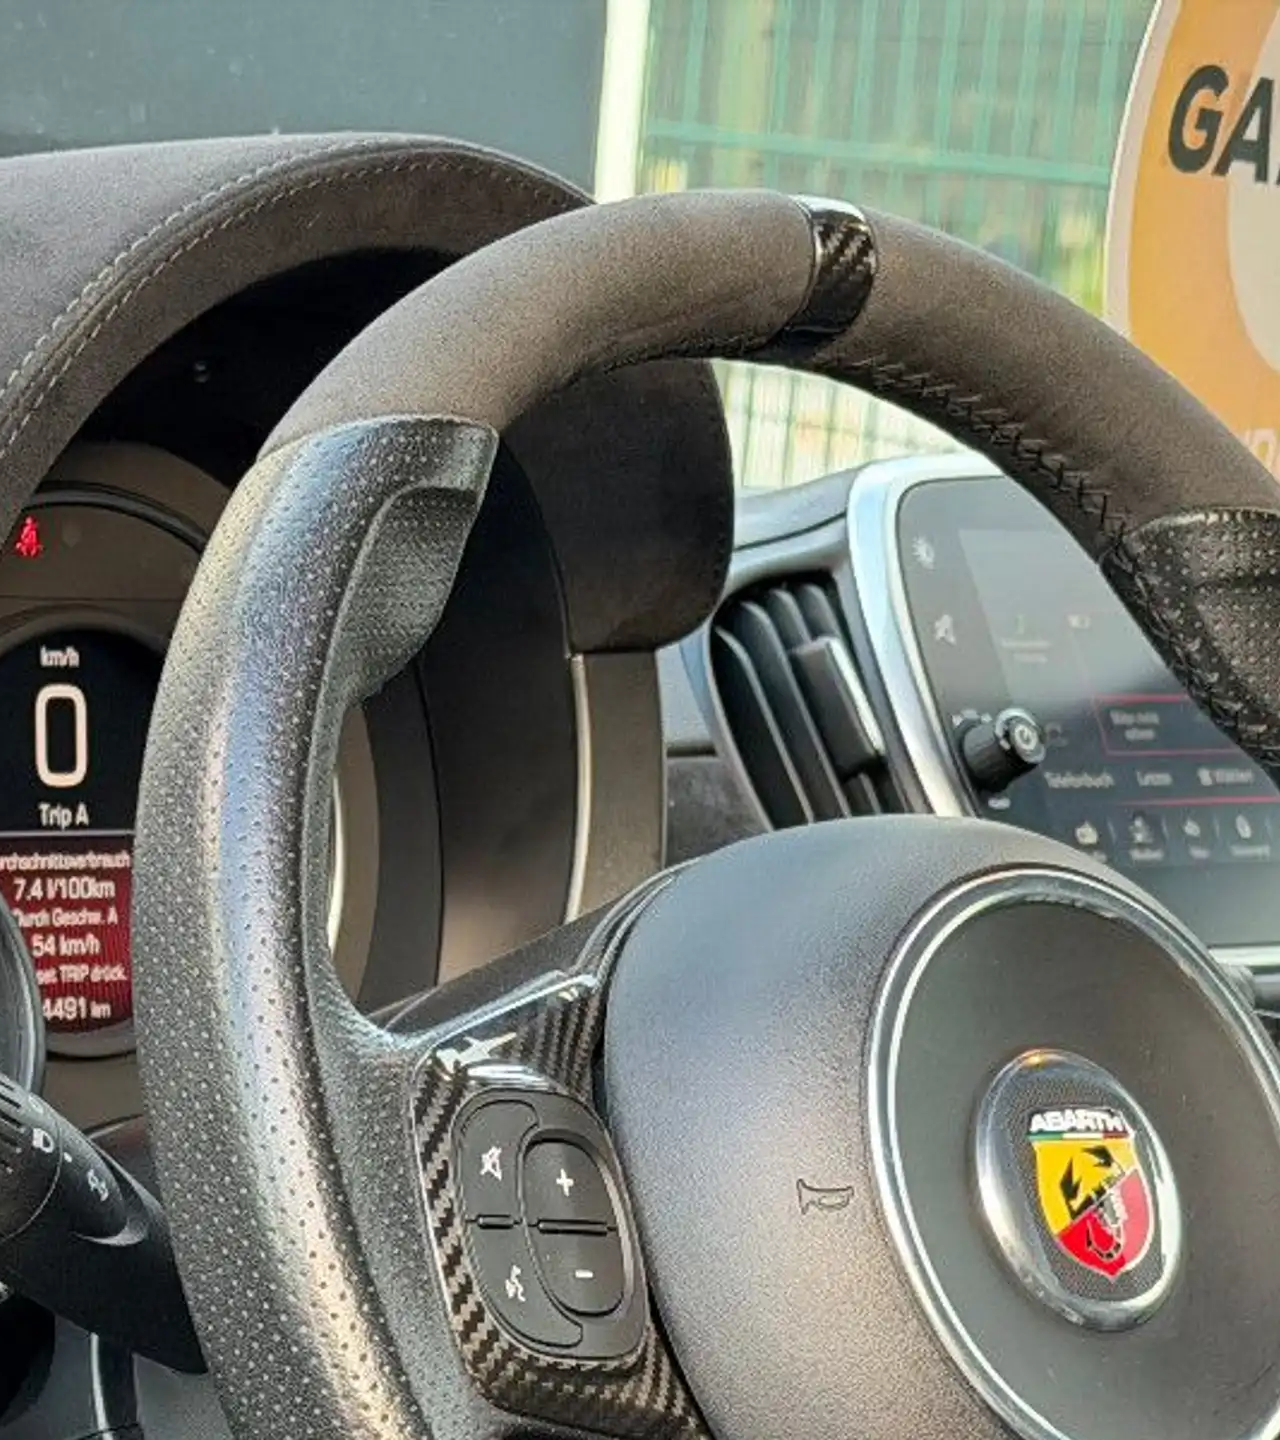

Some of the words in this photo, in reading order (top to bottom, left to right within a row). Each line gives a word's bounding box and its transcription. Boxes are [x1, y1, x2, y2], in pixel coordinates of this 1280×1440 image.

[40, 646, 80, 667] km/h
[35, 683, 88, 788] 0
[39, 803, 71, 831] Trip
[75, 803, 90, 826] A
[32, 935, 56, 957] 54
[58, 932, 101, 957] km/h
[89, 1000, 112, 1020] km
[1030, 1107, 1132, 1133] ABARTH
